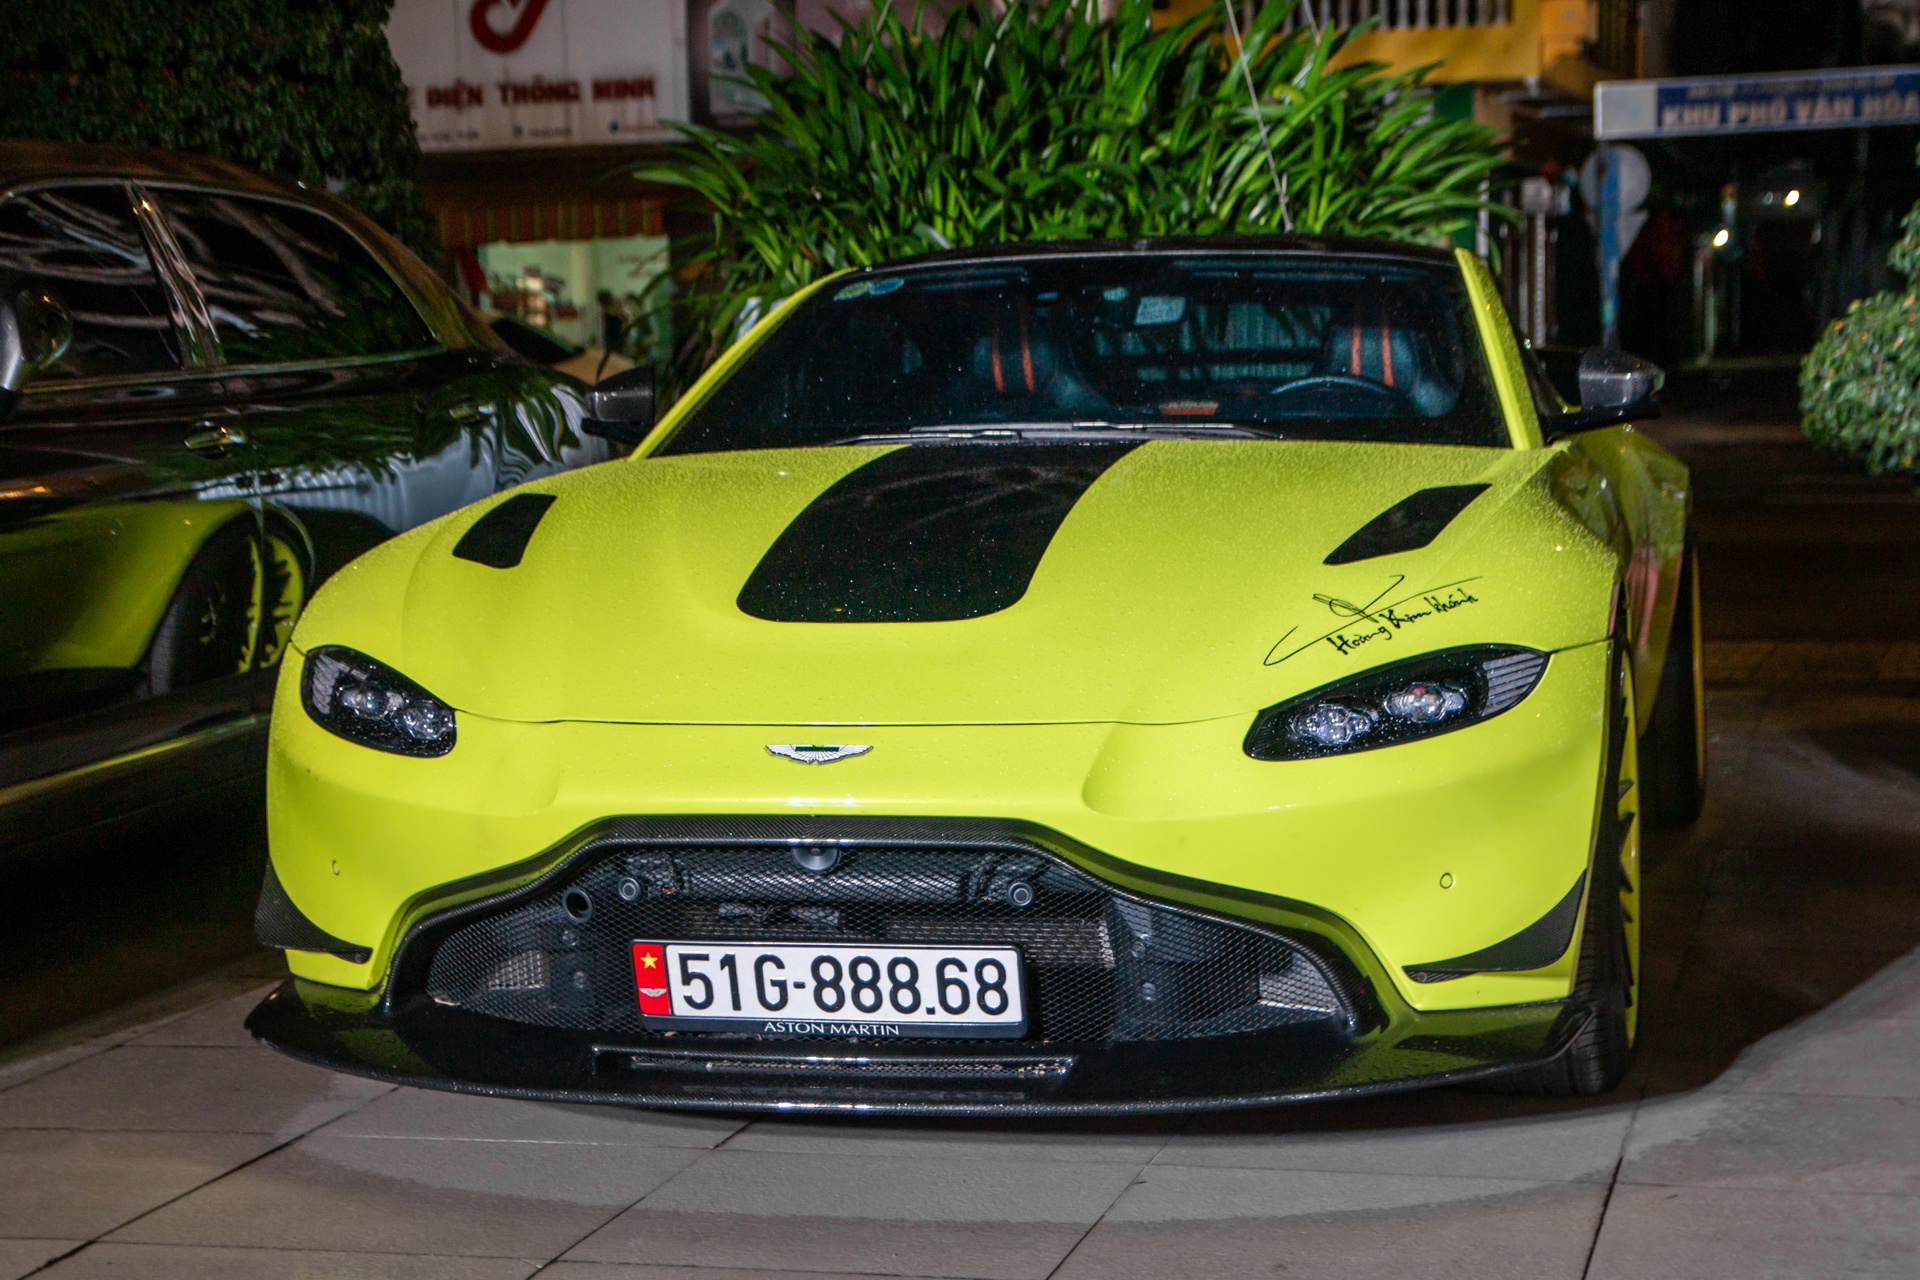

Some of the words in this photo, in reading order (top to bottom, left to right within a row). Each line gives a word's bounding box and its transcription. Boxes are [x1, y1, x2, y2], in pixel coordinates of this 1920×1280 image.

[678, 953, 1010, 1016] 51G-888.68
[764, 1021, 825, 1035] ASTON
[829, 1023, 900, 1036] MARTIN
